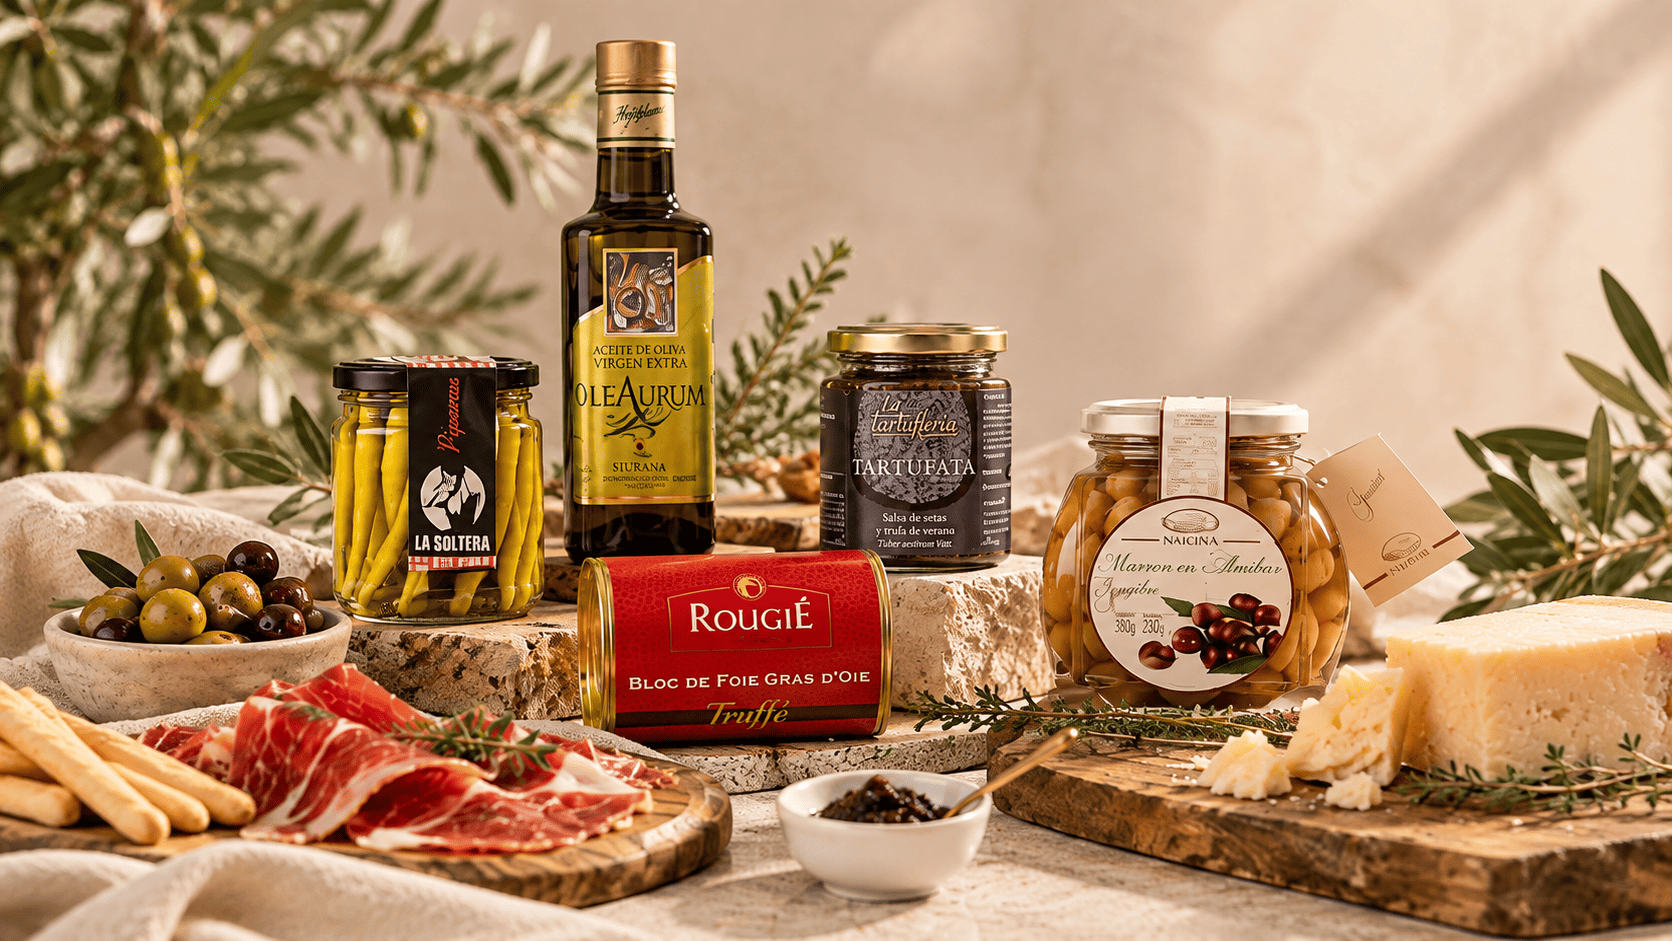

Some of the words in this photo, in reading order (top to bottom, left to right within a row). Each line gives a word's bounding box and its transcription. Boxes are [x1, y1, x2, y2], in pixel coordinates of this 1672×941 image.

[593, 345, 633, 355] ACEITE
[636, 345, 650, 355] DE
[653, 345, 686, 355] OLIVA
[594, 358, 643, 369] VIRGEN
[646, 358, 688, 369] EXTRA
[882, 395, 901, 412] La
[612, 462, 666, 472] SIURANA
[852, 458, 976, 476] TARTUFATA
[882, 512, 907, 522] Salsa
[909, 512, 921, 522] de
[922, 513, 947, 522] setas
[875, 527, 882, 538] y
[909, 526, 921, 535] de
[922, 527, 955, 535] verano
[1163, 535, 1219, 546] NAICINA
[414, 534, 430, 551] LA
[433, 534, 490, 551] SOLTERA
[1098, 552, 1174, 573] Marron
[1176, 563, 1197, 573] en
[1142, 619, 1165, 637] 230g
[629, 676, 678, 690] BLOC
[686, 677, 710, 689] DE
[717, 674, 759, 688] FOIE
[764, 672, 815, 686] GRAS
[707, 699, 789, 730] Truffé
